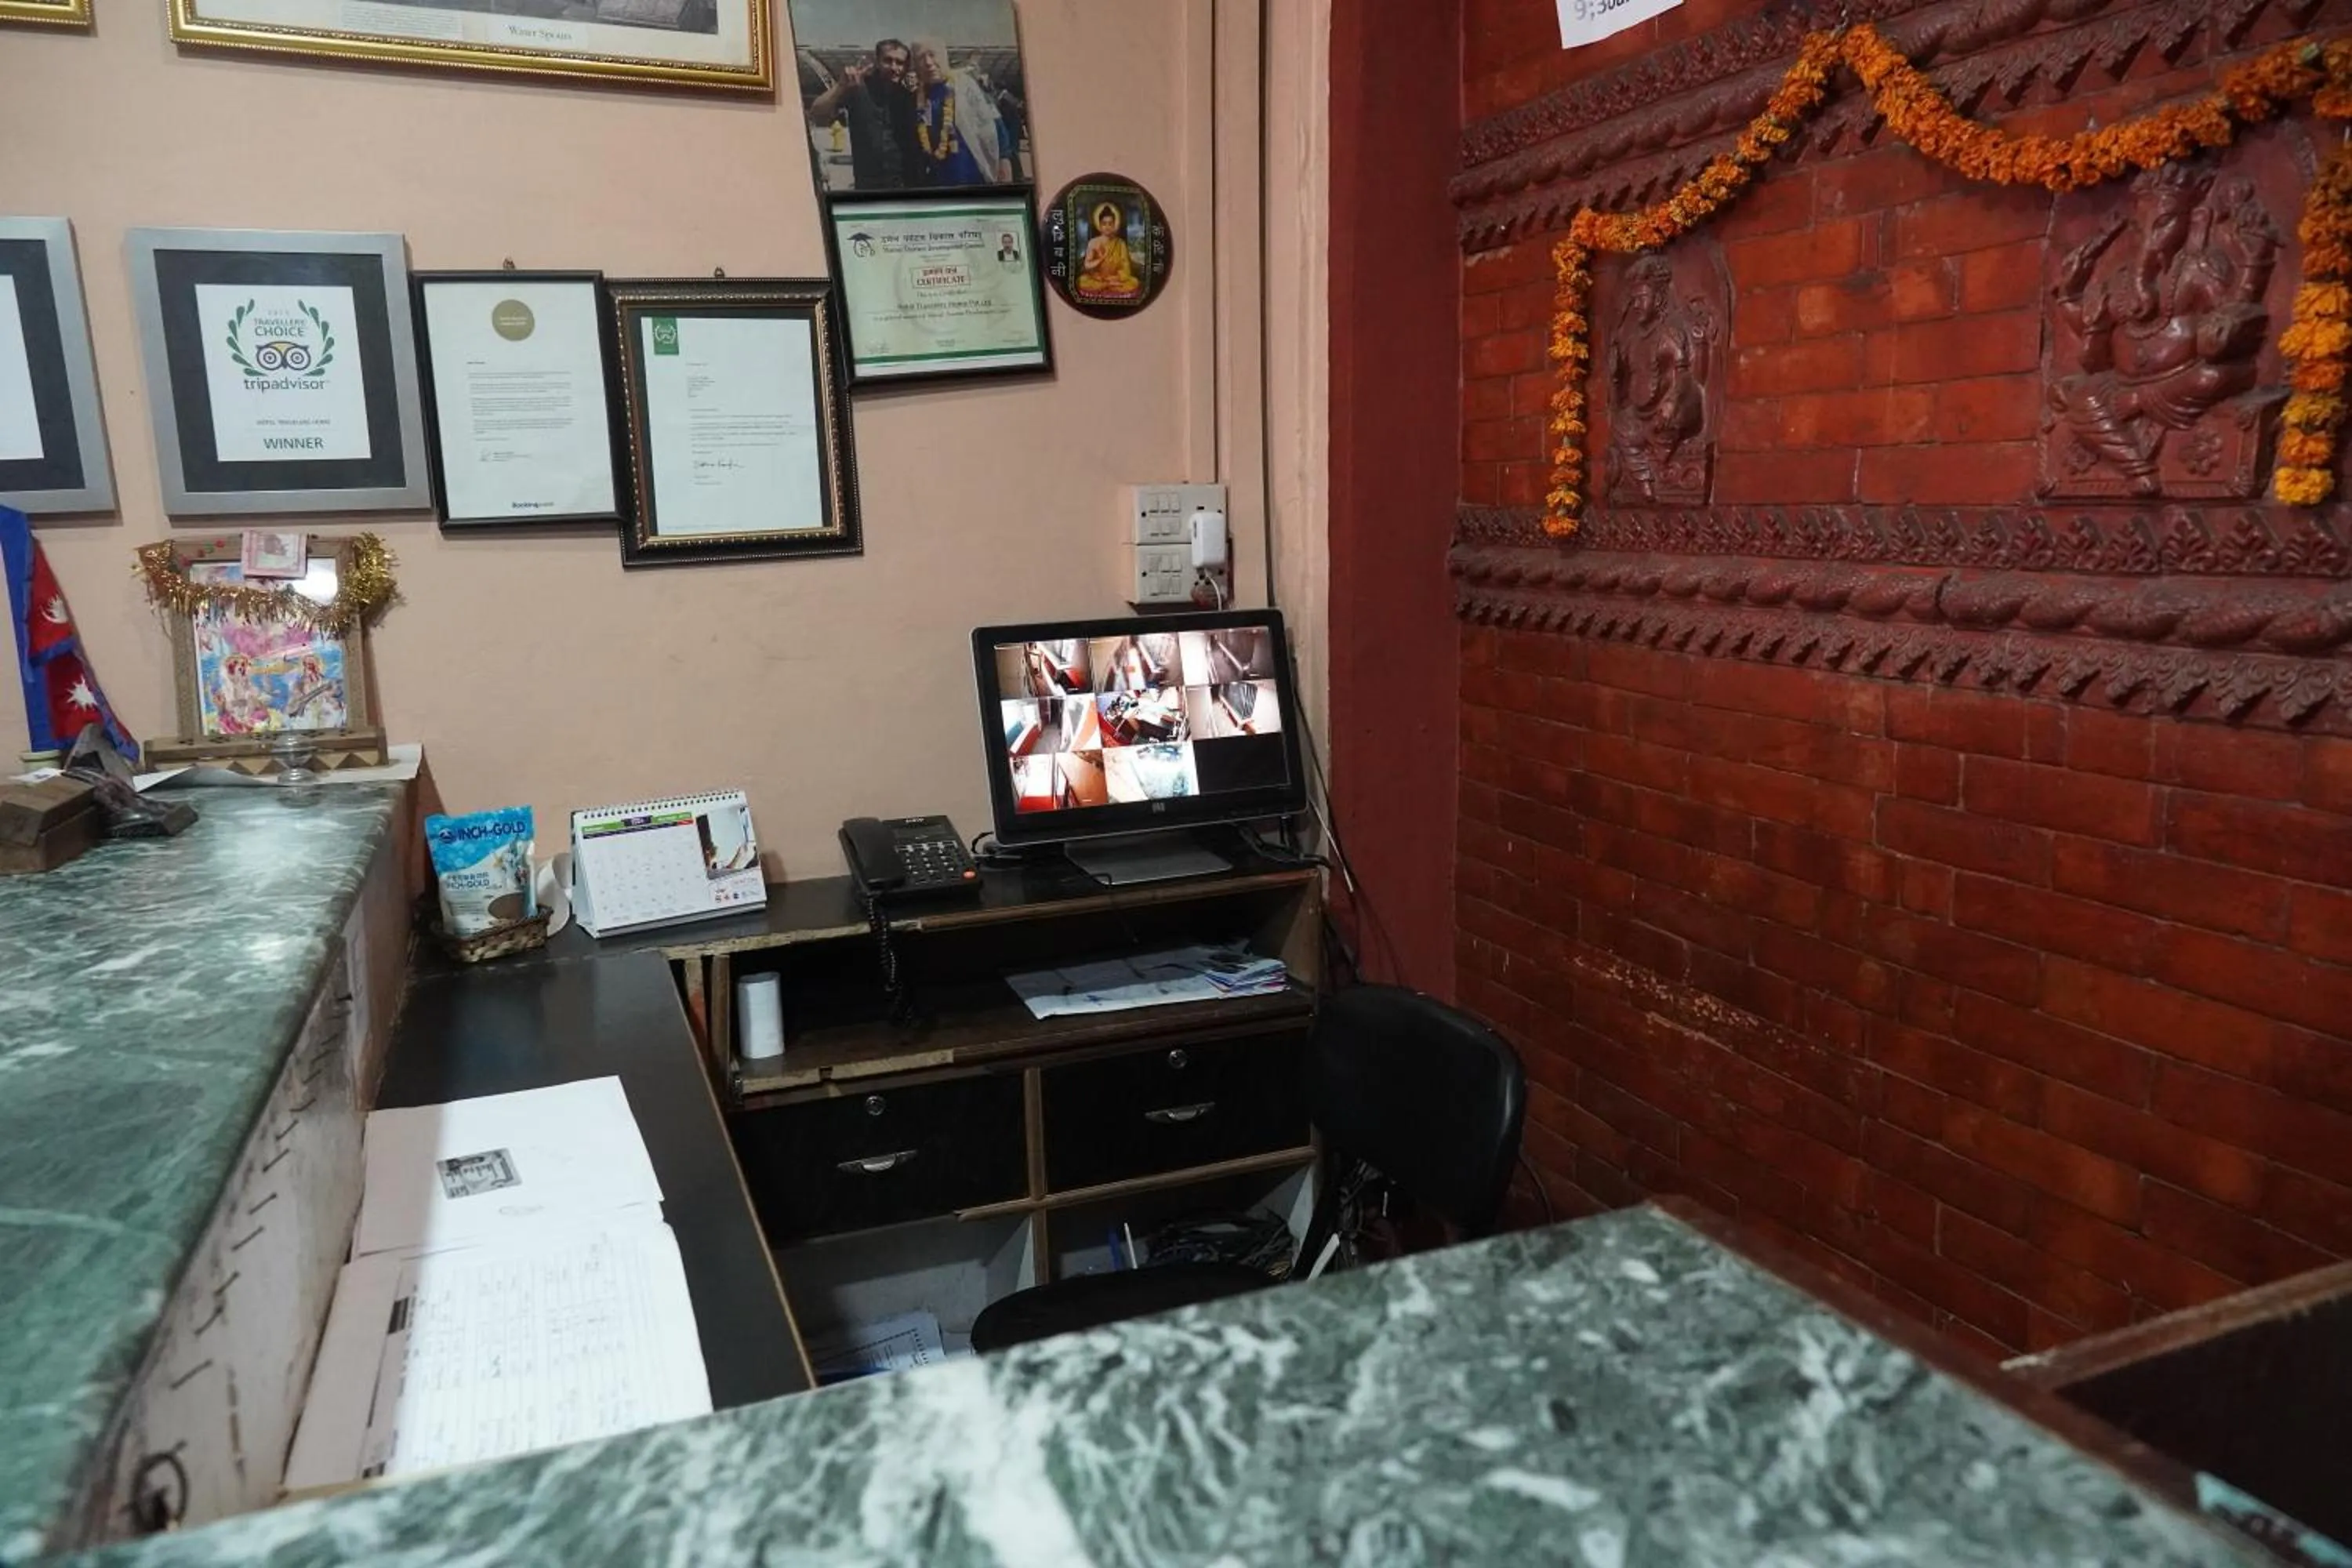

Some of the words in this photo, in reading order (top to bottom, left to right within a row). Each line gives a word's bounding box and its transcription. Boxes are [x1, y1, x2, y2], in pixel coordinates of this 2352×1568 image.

[1574, 0, 1630, 20] 9;30
[255, 325, 305, 337] CHOICE
[244, 376, 326, 394] tripadvisor
[263, 437, 325, 449] WINNER
